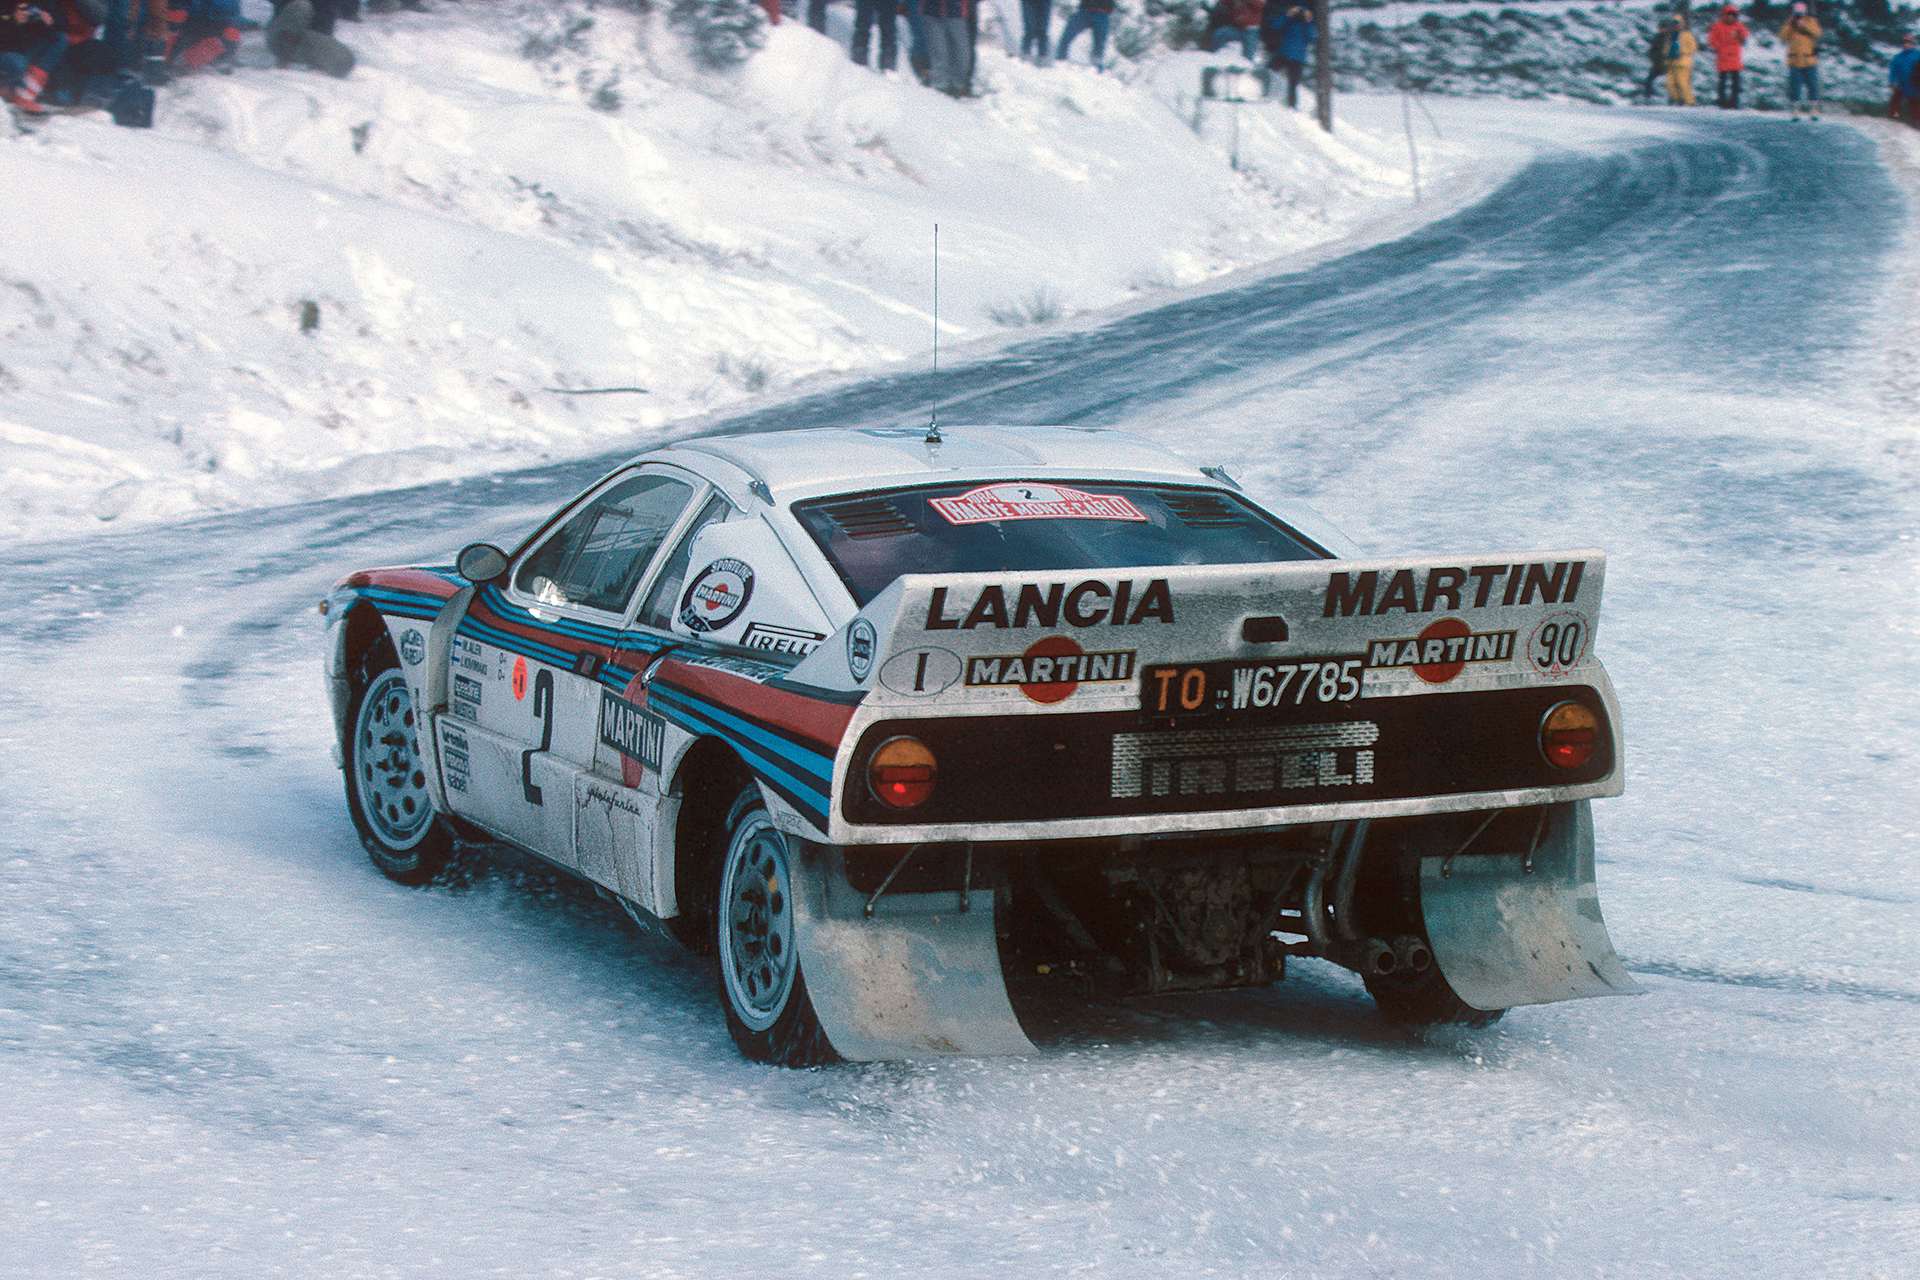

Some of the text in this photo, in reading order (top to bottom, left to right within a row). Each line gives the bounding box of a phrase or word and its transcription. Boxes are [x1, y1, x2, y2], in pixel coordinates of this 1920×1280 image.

[948, 500, 1013, 519] RALLYE
[1018, 489, 1039, 500] 2
[697, 584, 739, 608] MARTINI
[925, 578, 1176, 631] LANCIA
[1323, 561, 1586, 618] MARTINI
[1370, 631, 1511, 667] MARTINI
[1537, 622, 1579, 668] 90
[914, 652, 930, 691] I
[972, 653, 1130, 684] MARTINI
[1155, 668, 1206, 711] TO
[1232, 660, 1362, 709] W67785
[603, 698, 662, 767] MARTINI
